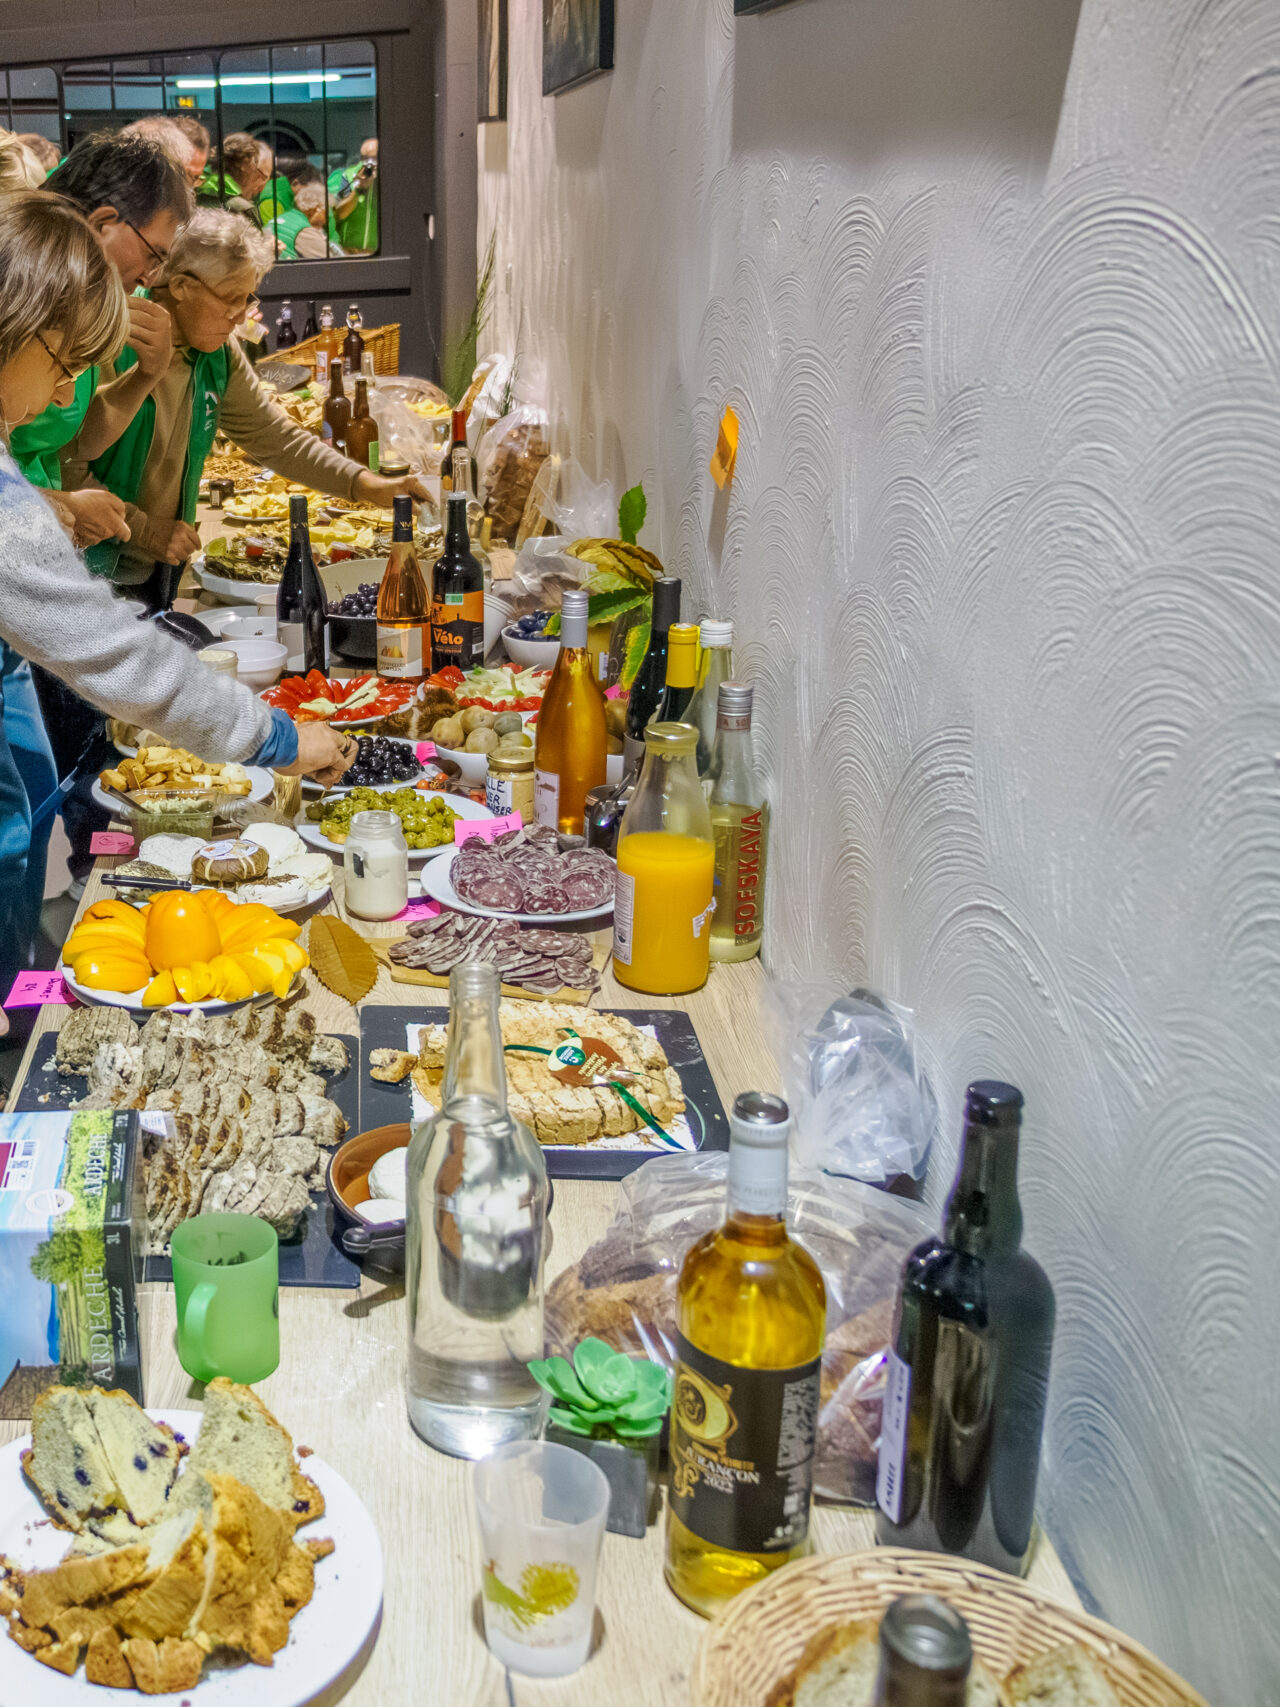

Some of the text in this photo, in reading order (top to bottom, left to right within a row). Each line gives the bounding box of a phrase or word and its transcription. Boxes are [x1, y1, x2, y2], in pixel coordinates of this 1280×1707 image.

[433, 627, 464, 645] Vélo
[734, 810, 762, 936] SOFSKAYA
[106, 1231, 120, 1245] 3L
